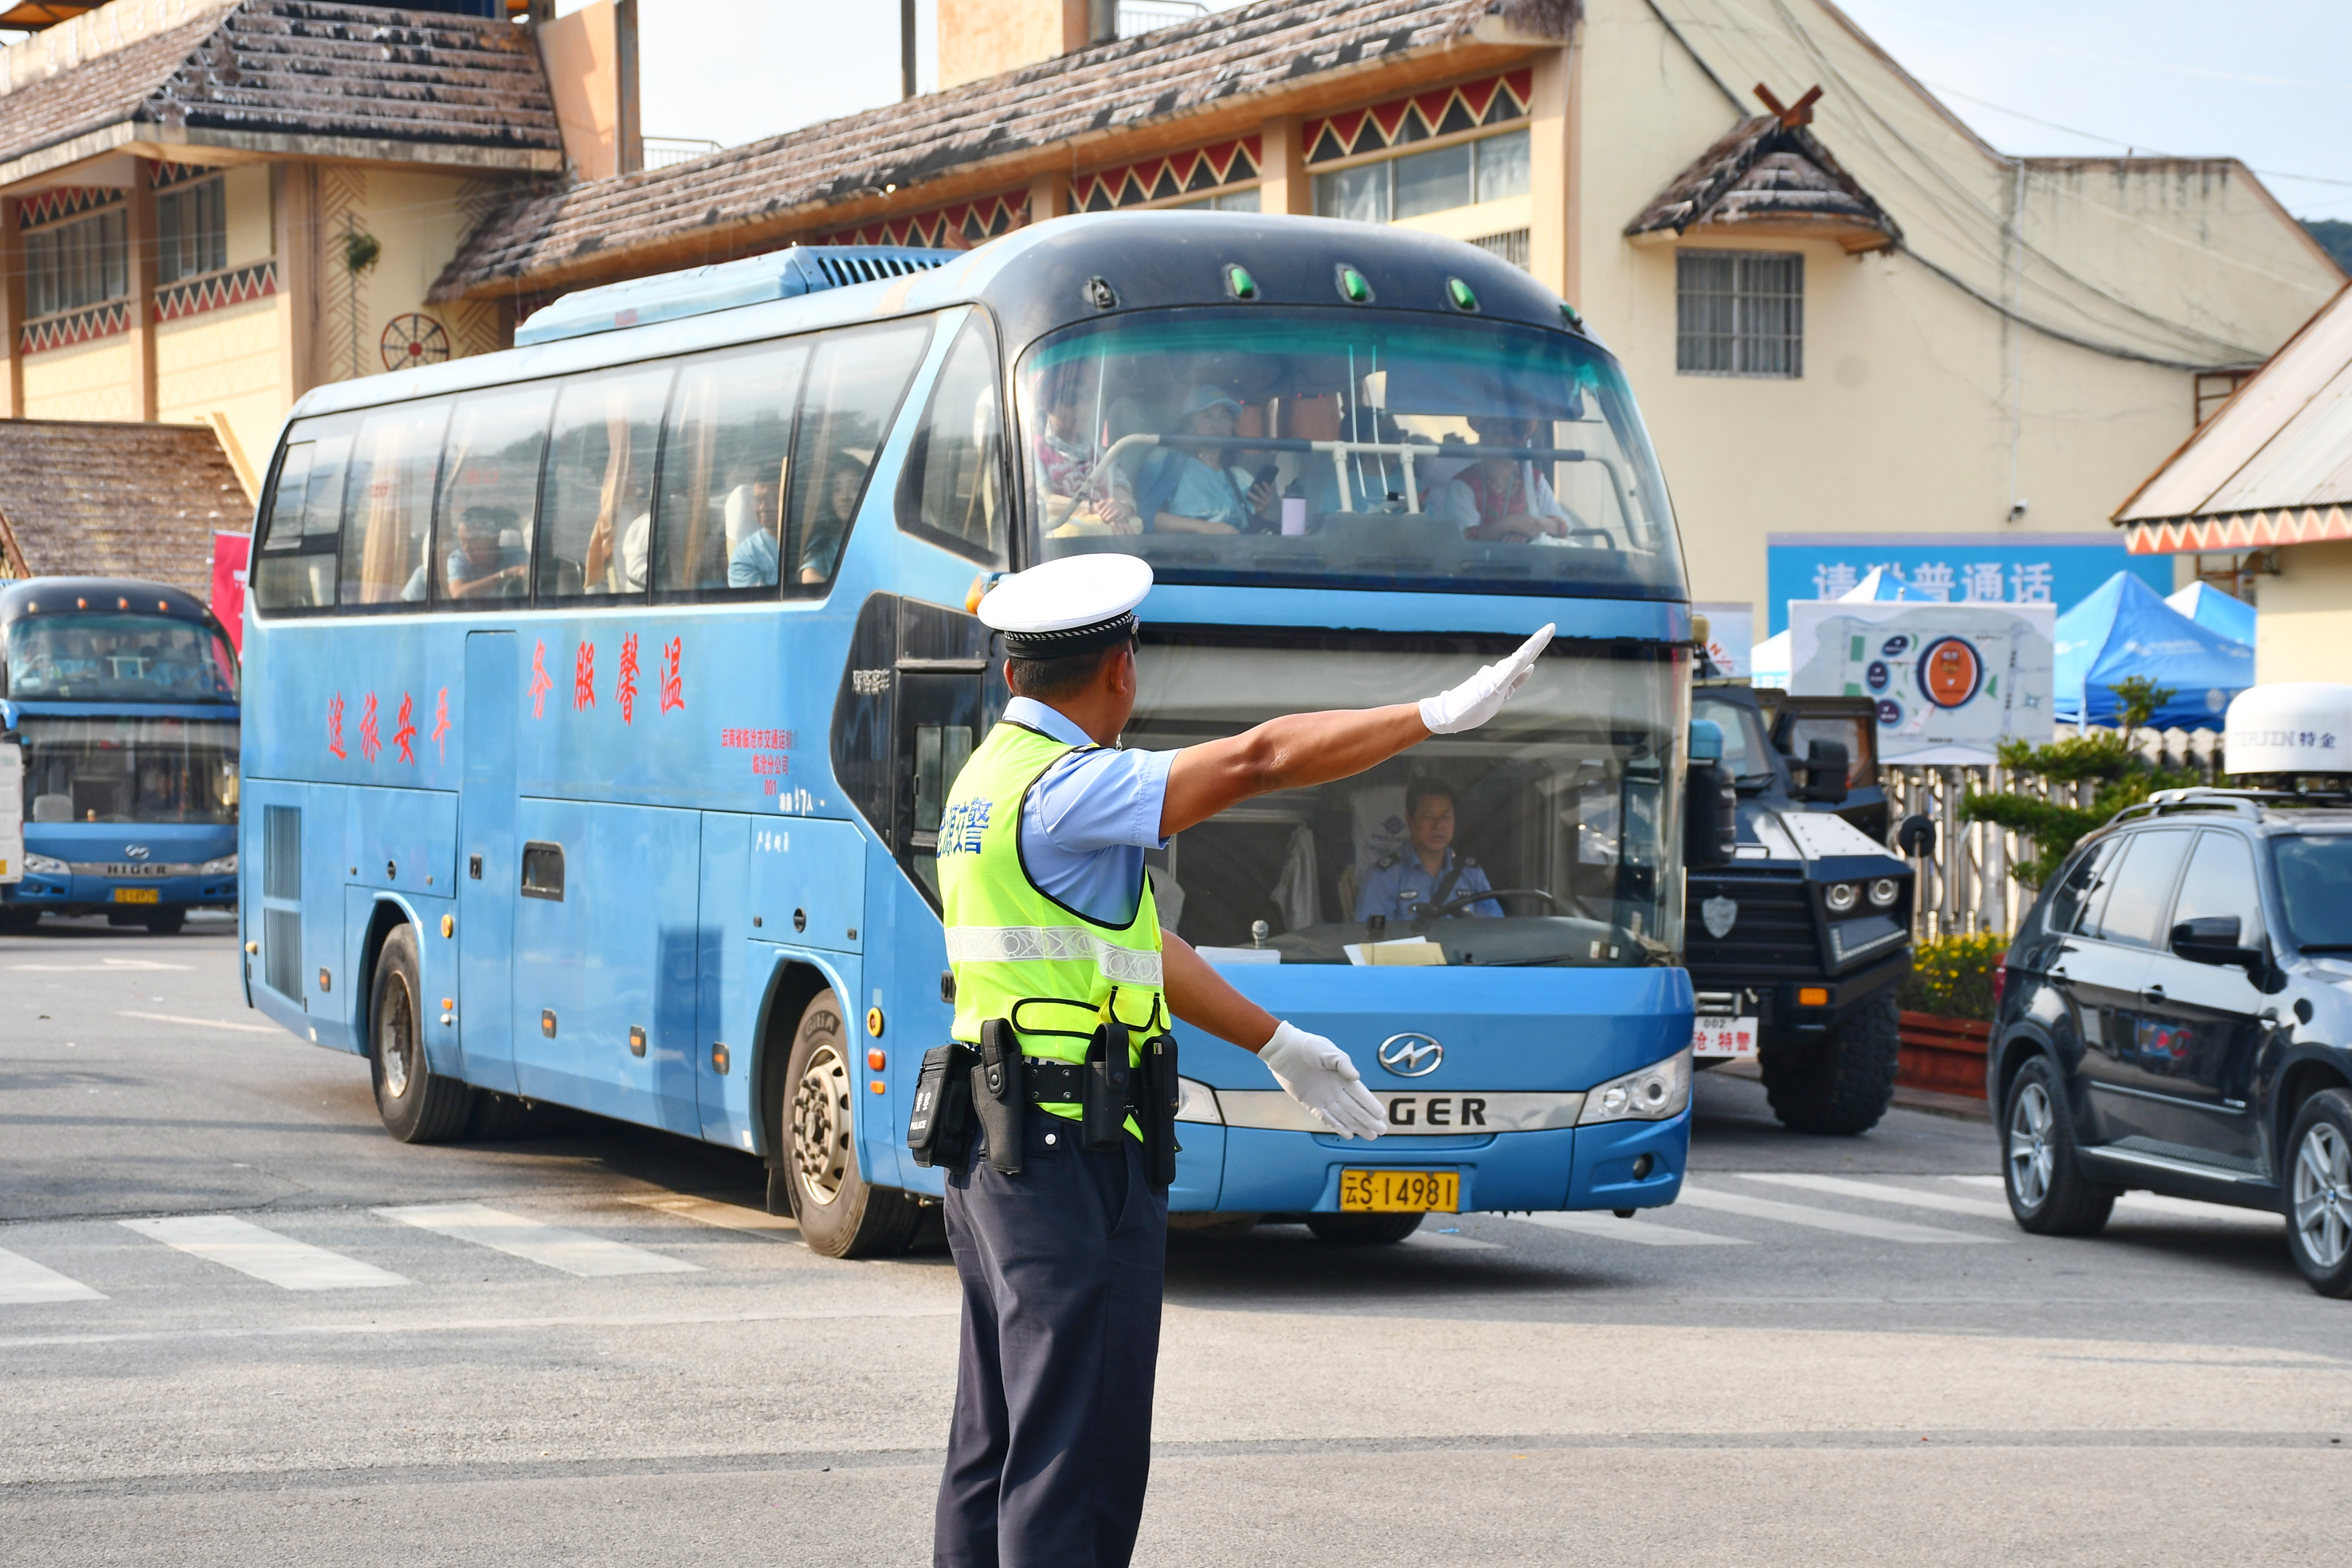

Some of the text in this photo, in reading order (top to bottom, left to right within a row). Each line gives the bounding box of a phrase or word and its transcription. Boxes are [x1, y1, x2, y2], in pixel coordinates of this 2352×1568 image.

[753, 754, 789, 775] 临沧分公司
[764, 780, 777, 796] 001
[1704, 1018, 1726, 1029] 002
[1694, 1032, 1750, 1051] 沧·特警
[1389, 1098, 1486, 1126] GER
